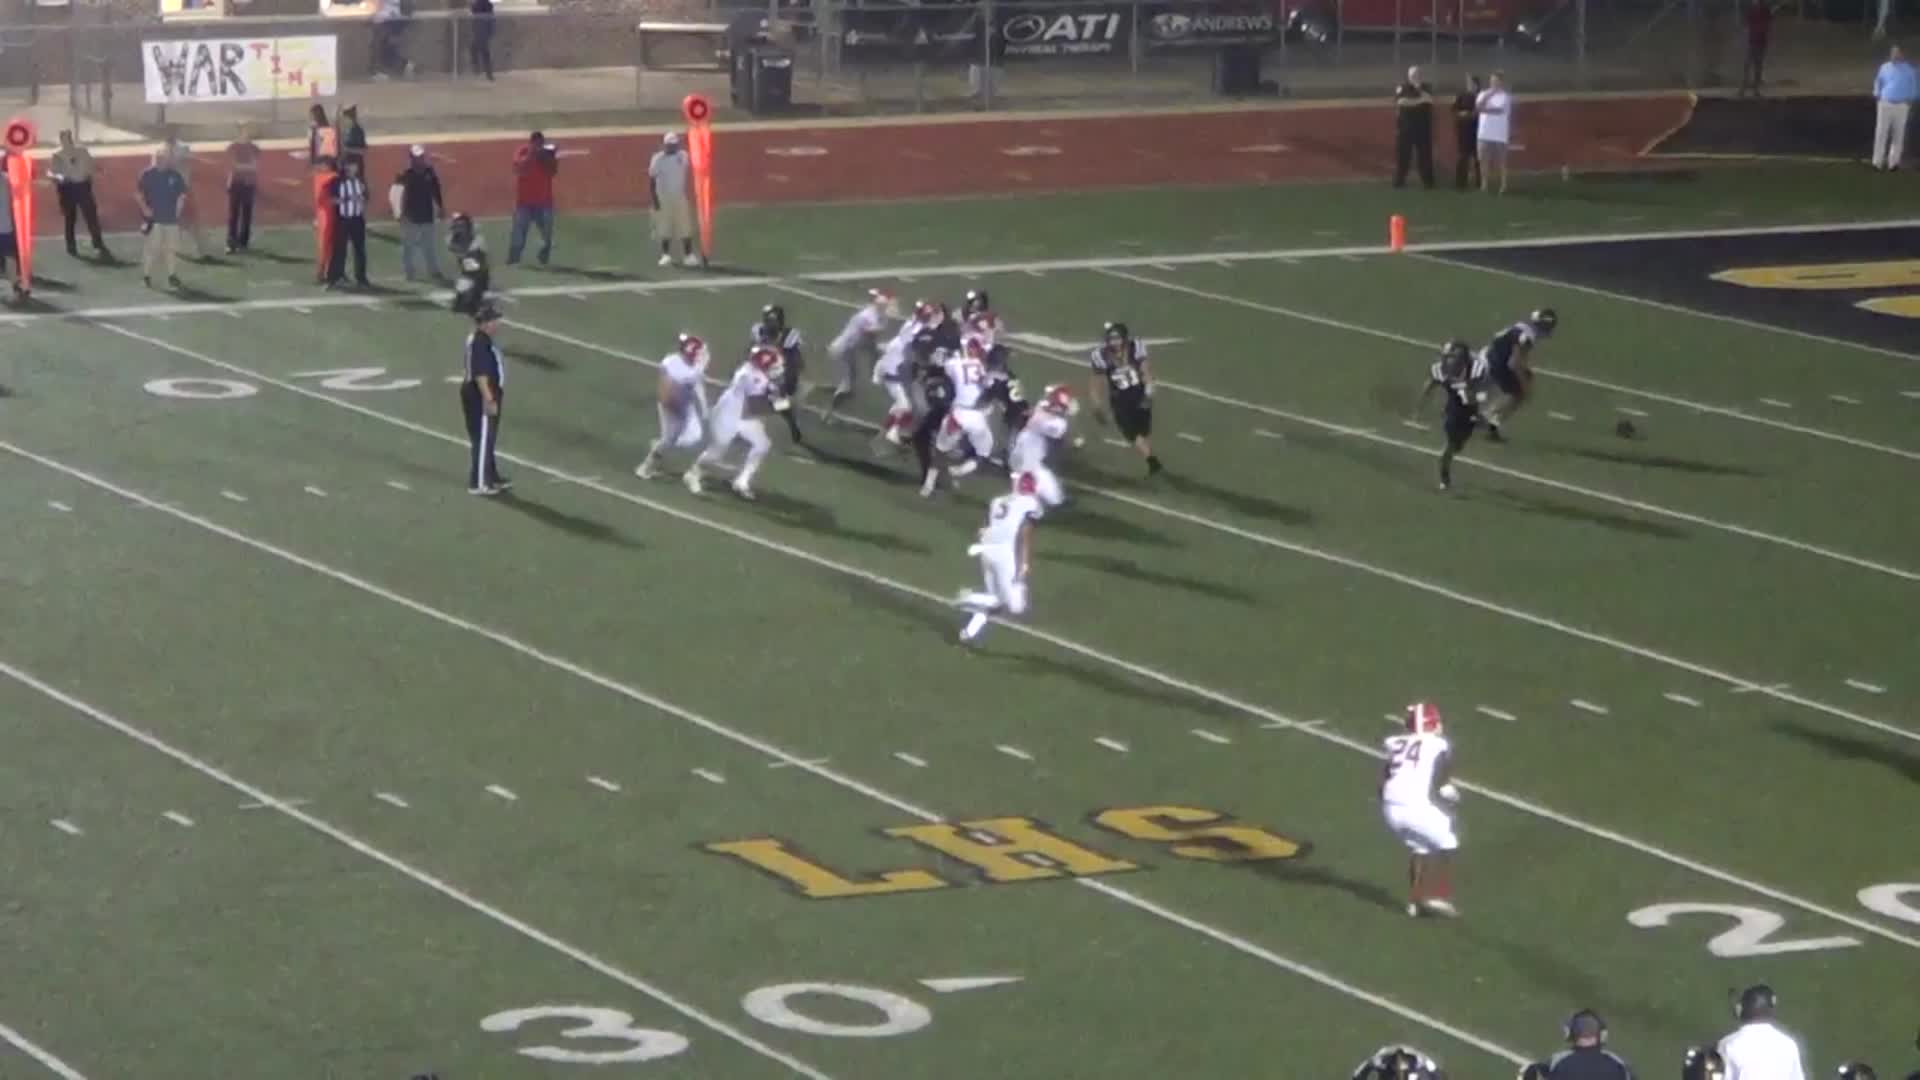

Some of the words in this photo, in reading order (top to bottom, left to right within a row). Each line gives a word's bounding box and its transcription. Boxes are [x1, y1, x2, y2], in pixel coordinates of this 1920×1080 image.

[1043, 13, 1121, 40] ATI
[1193, 15, 1272, 31] ANDREWS
[152, 43, 247, 97] WAR
[1391, 739, 1422, 769] 24
[696, 804, 1306, 899] LHS
